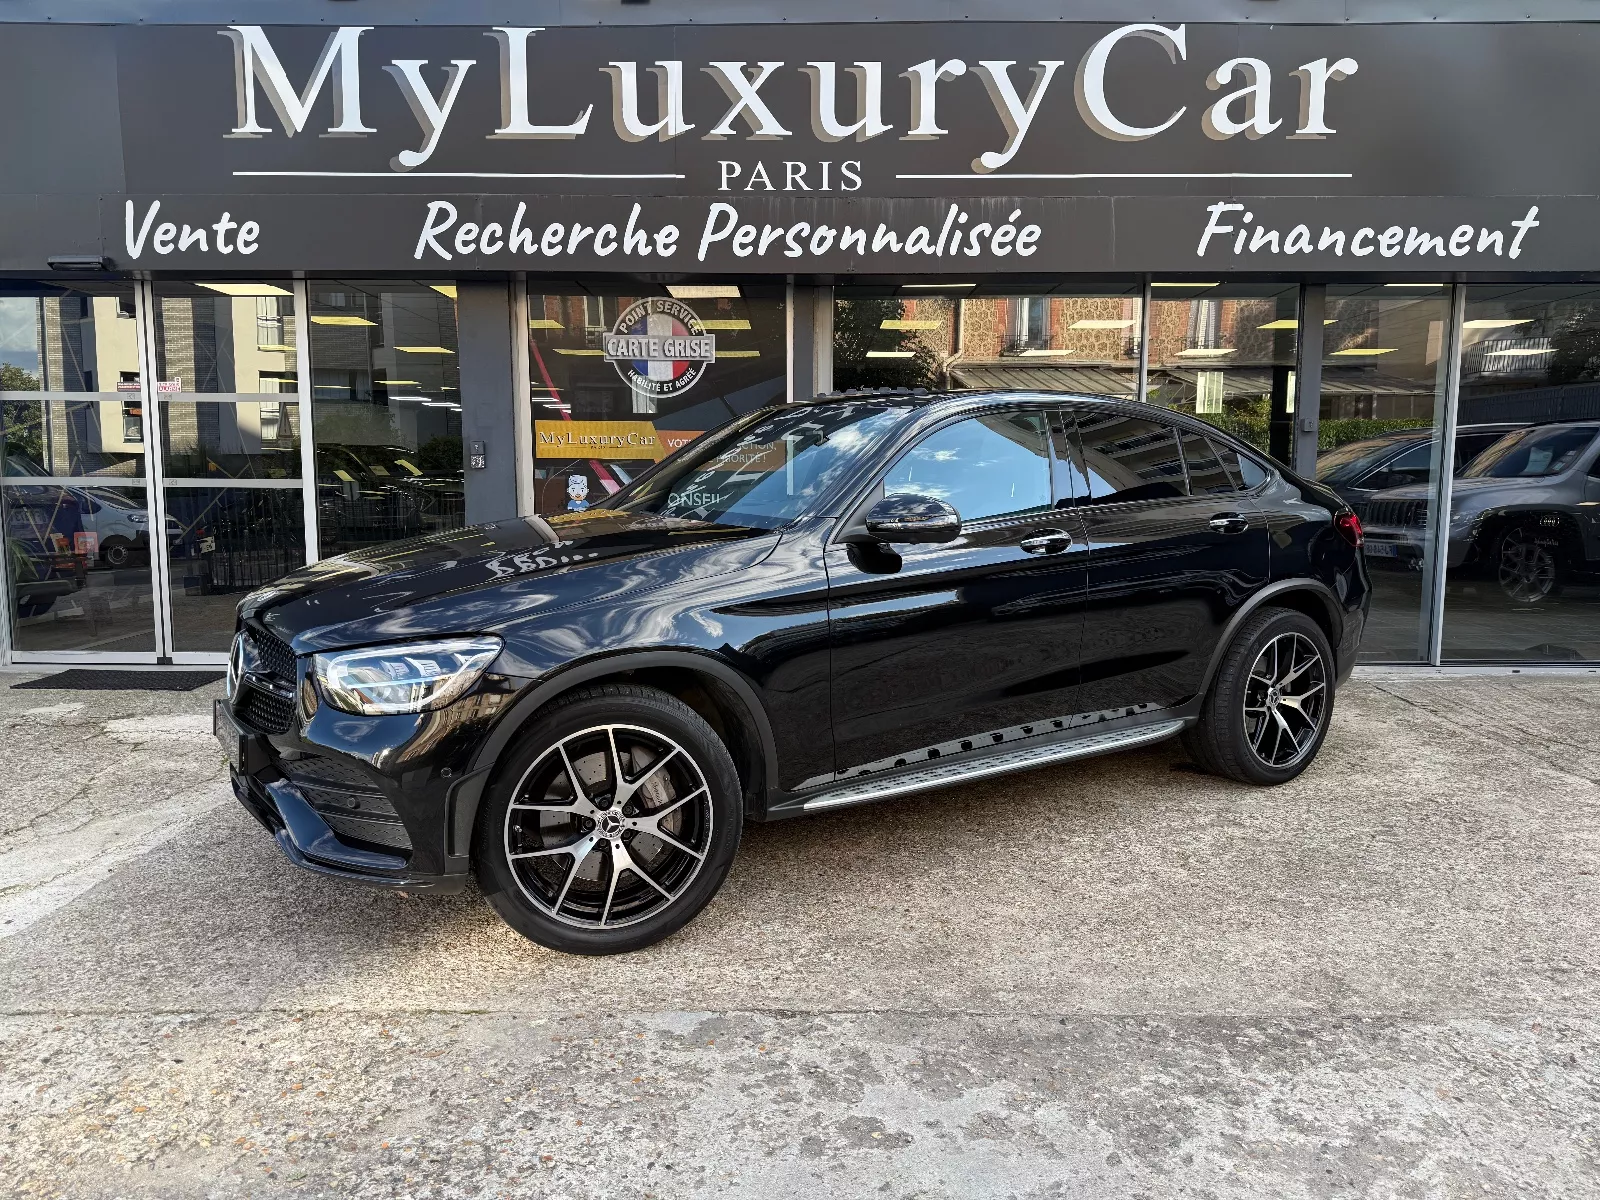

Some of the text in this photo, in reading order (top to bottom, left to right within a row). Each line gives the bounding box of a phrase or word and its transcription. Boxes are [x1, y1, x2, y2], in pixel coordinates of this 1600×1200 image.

[220, 23, 1358, 170] MyLuxuryCar
[717, 160, 863, 192] PARIS
[124, 199, 261, 260] Vente
[413, 200, 1042, 262] Recherche Personnalisée
[1196, 200, 1541, 260] Financement
[619, 300, 703, 336] POINT SERVICE
[607, 338, 712, 359] CARTE GRISE
[663, 383, 673, 392] ET
[539, 431, 656, 448] MyLuxuryCar
